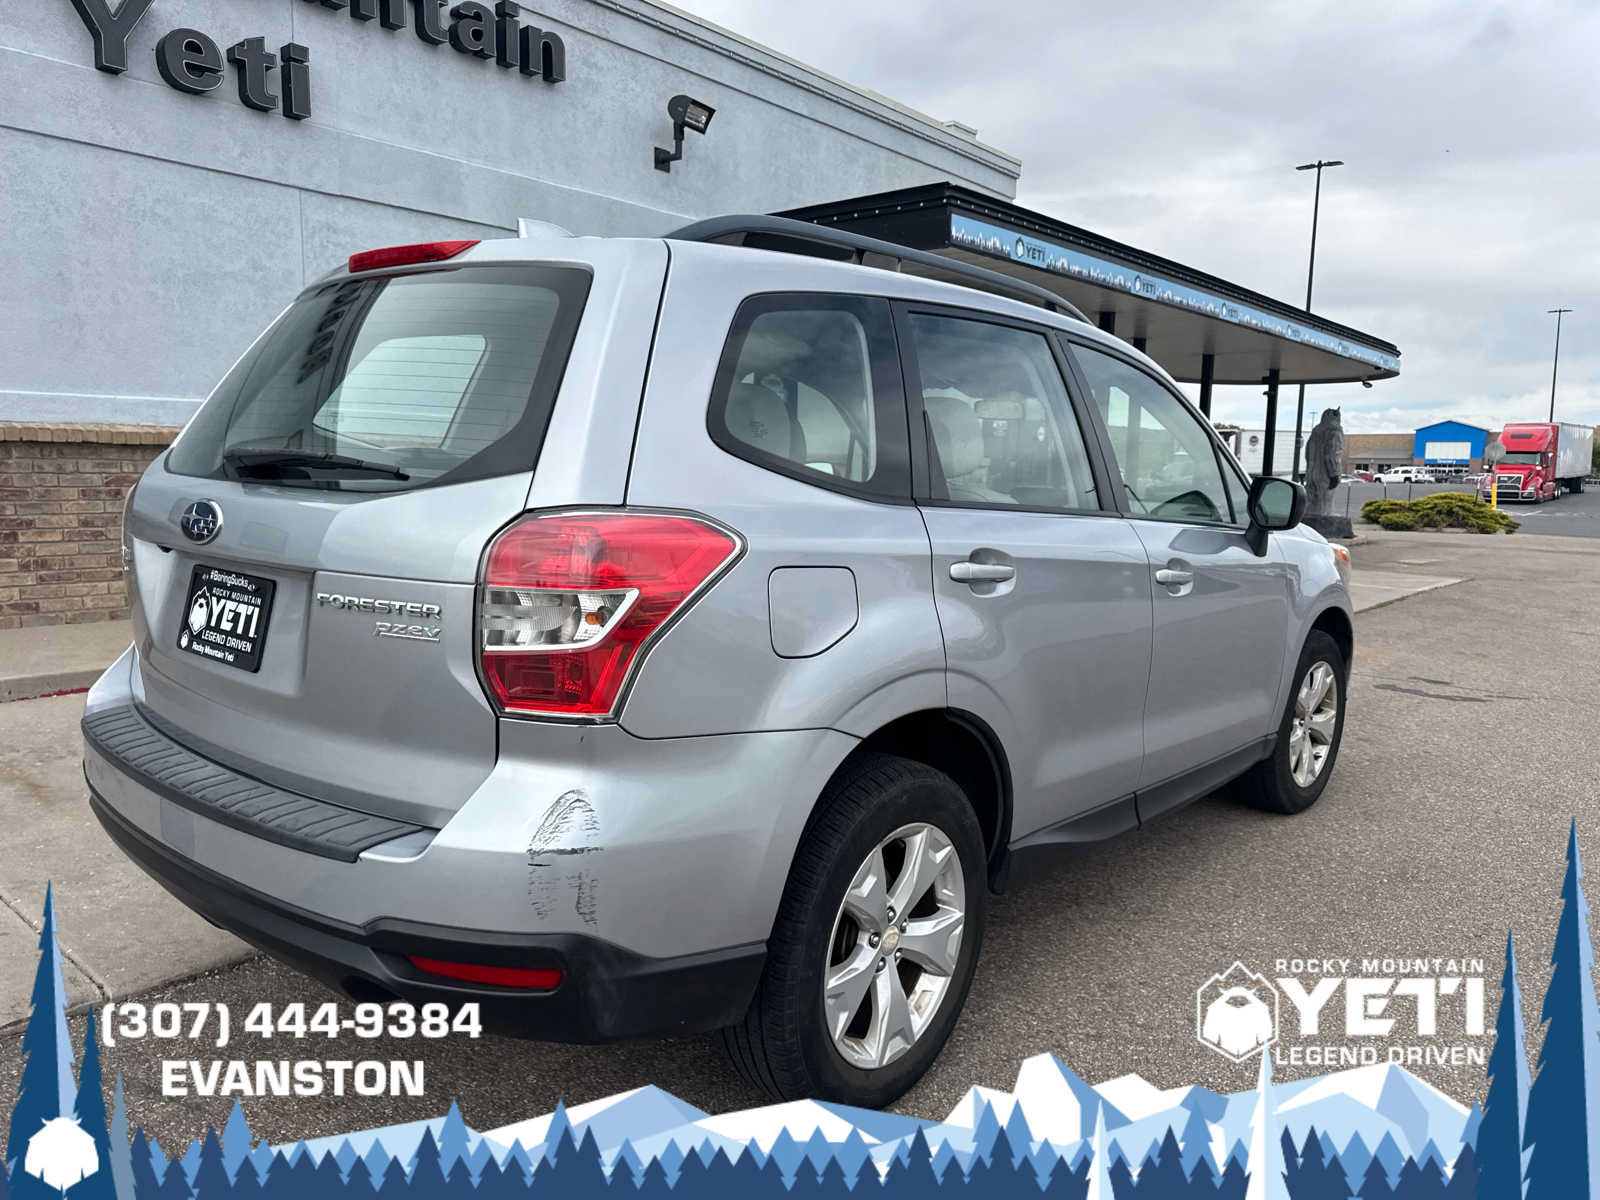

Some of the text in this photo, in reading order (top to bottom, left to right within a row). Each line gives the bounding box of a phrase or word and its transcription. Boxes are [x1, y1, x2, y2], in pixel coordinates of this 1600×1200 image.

[71, 0, 312, 120] Yeti
[1026, 245, 1046, 262] YETI
[212, 587, 262, 606] ROCKY MOUNTAIN
[317, 592, 441, 620] FORESTER
[210, 596, 260, 638] YETI
[192, 641, 205, 654] Rocky
[204, 645, 225, 659] Mountain
[201, 630, 253, 653] LEGEND DRIVEN
